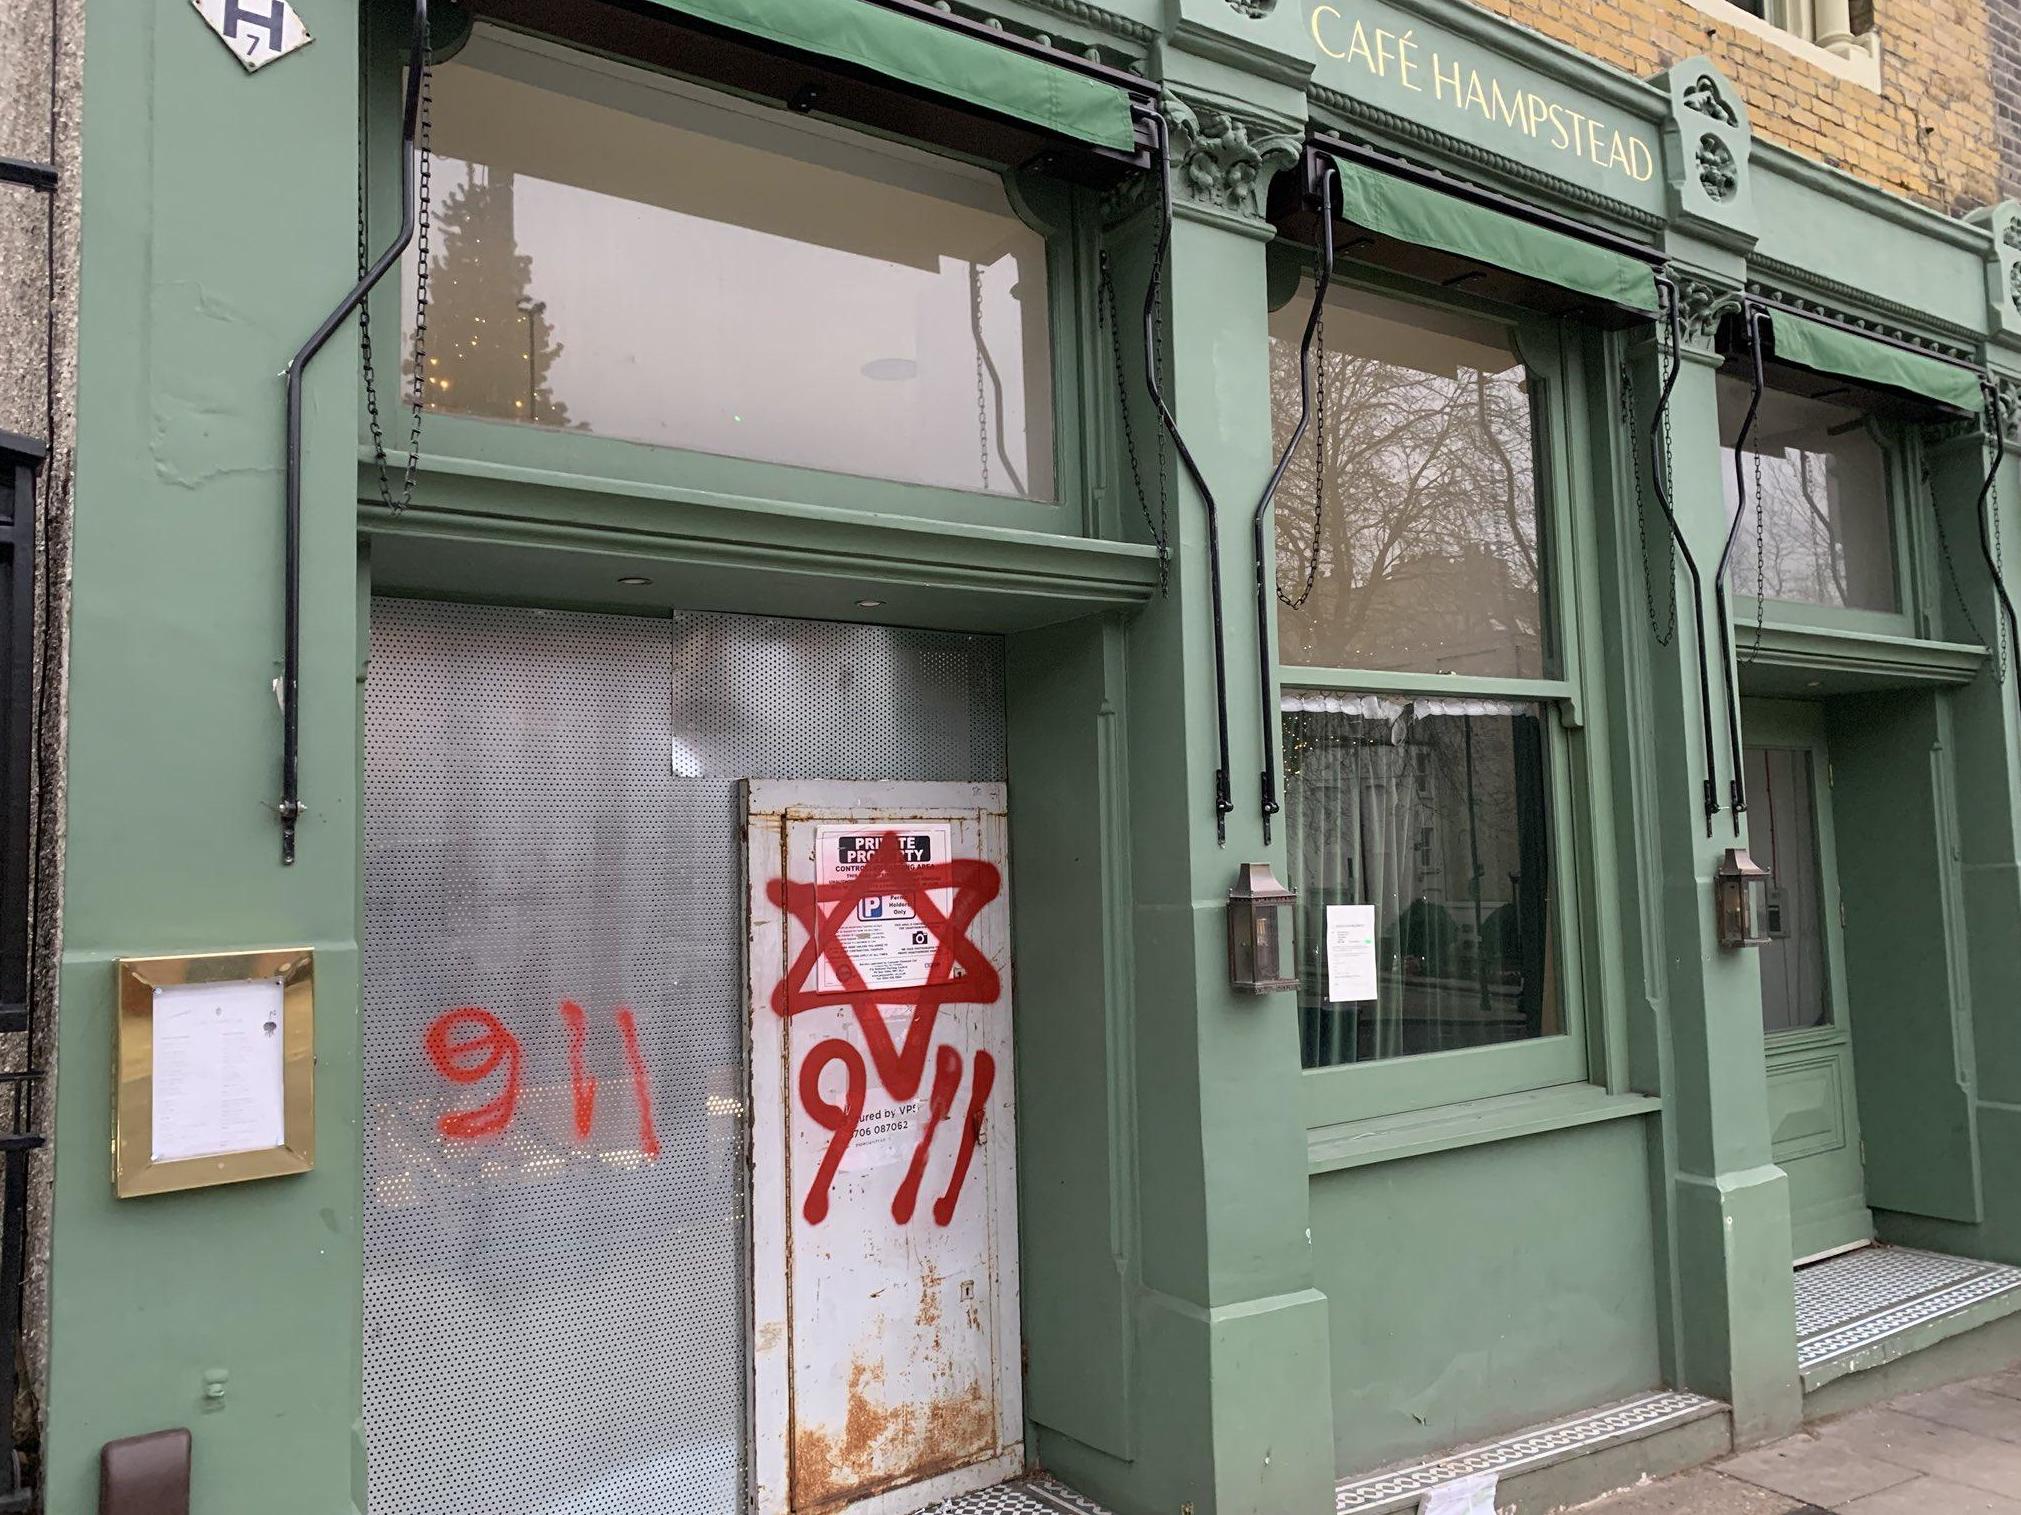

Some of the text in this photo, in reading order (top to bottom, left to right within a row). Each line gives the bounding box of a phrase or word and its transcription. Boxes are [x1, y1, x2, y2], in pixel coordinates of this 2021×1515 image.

[246, 33, 260, 56] 7
[1311, 5, 1653, 182] CAFÉ HAMPSTEAD
[855, 837, 916, 850] PRITE
[884, 1108, 896, 1118] by
[850, 1120, 909, 1138] 706 087062
